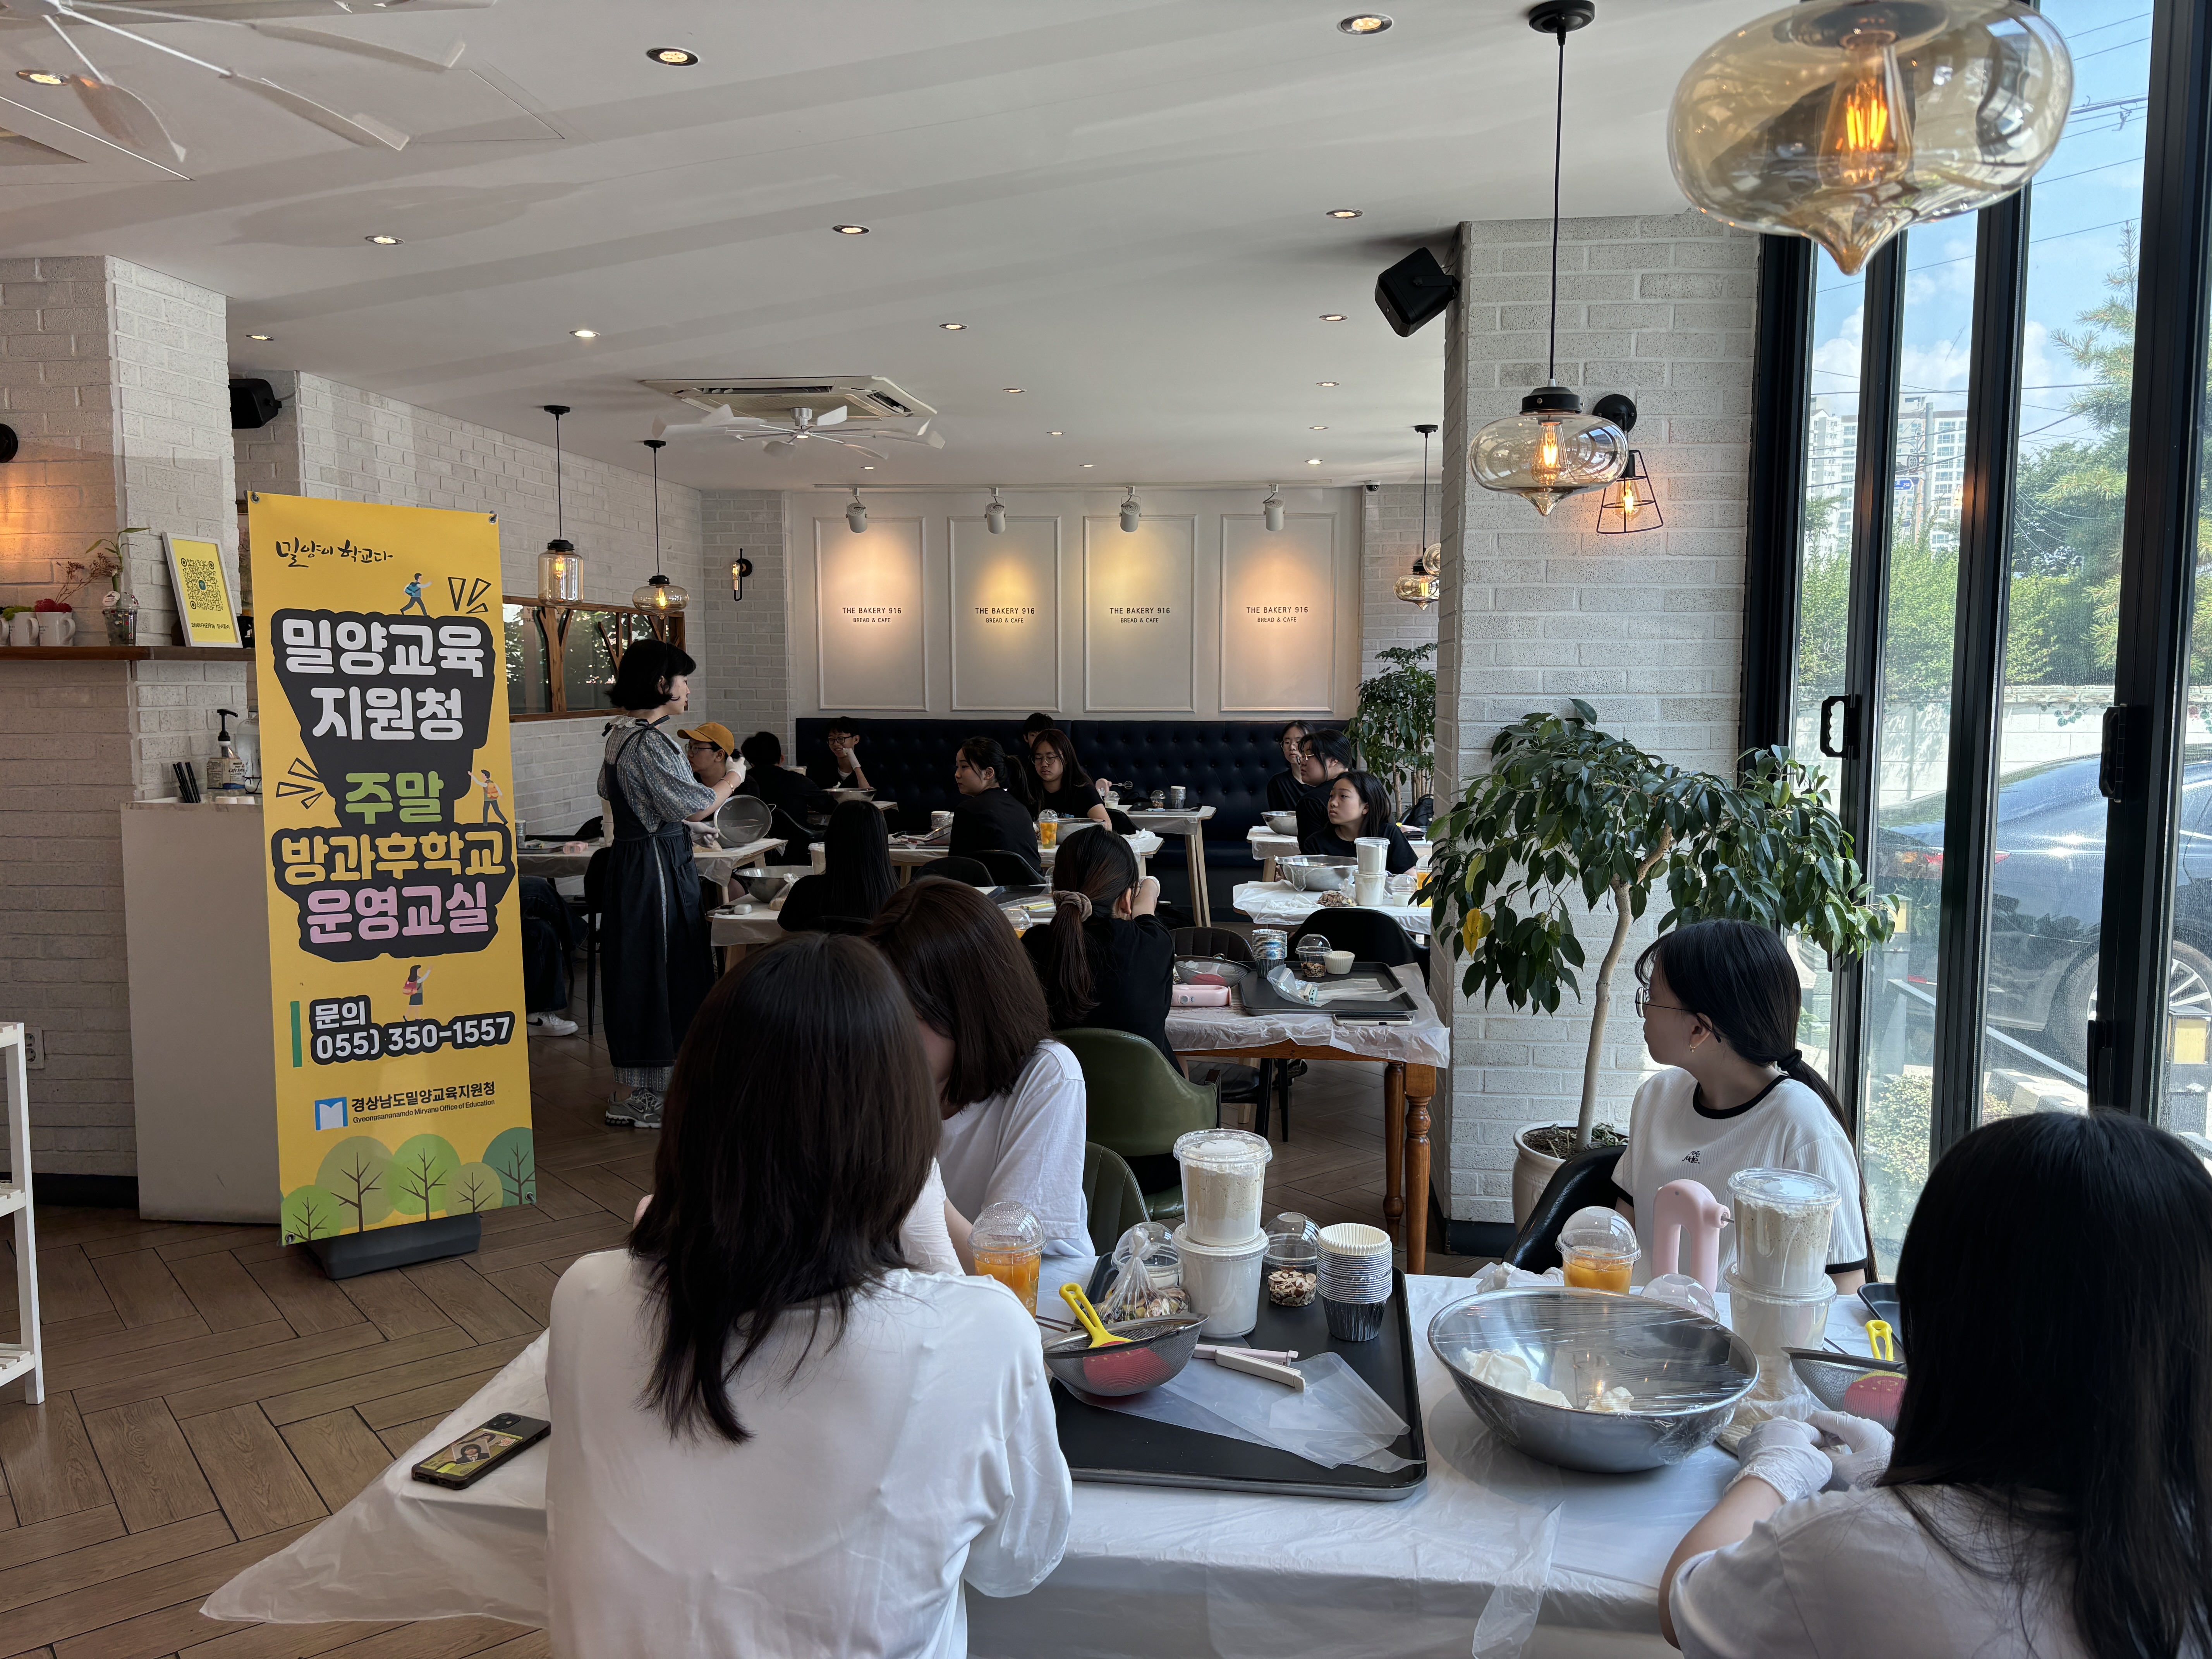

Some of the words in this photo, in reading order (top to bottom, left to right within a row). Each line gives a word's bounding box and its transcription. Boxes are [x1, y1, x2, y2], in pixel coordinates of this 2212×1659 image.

[282, 618, 484, 678] 밀양교육
[310, 686, 464, 740] 지원청
[345, 770, 445, 824] 주말
[281, 831, 506, 885] 방과후학교
[306, 881, 489, 944] 운영교실
[315, 1000, 366, 1029] 문의
[316, 1029, 380, 1059] 055)
[388, 1017, 510, 1051] 350-1557
[351, 1080, 495, 1113] 경상남도밀양교육지원청
[414, 1106, 439, 1116] Miryang
[440, 1103, 457, 1112] Office
[465, 1099, 495, 1109] Education
